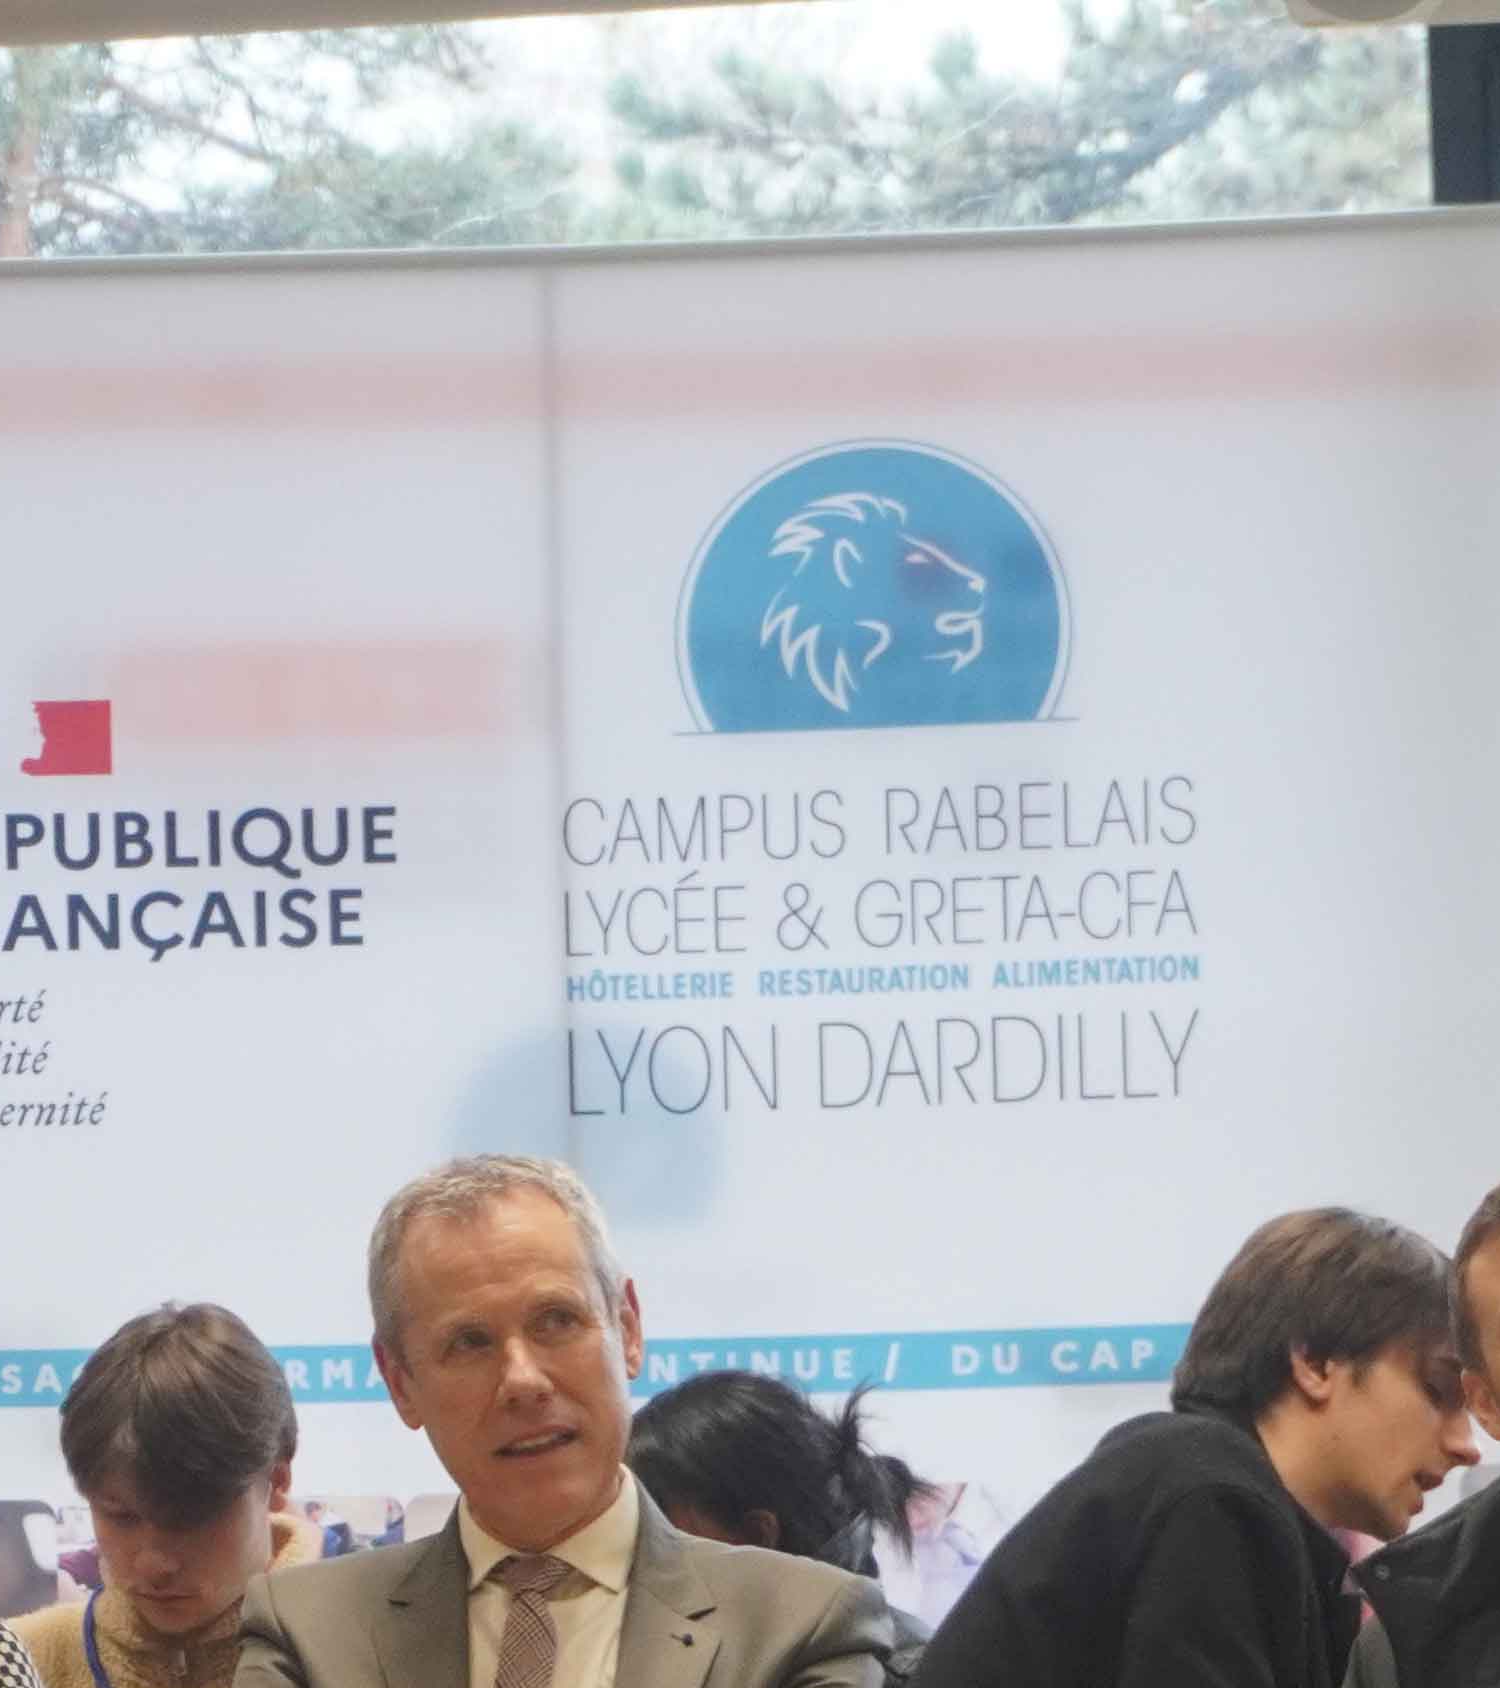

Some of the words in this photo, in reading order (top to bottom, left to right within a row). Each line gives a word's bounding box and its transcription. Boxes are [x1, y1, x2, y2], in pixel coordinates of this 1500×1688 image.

[562, 789, 846, 867] CAMPUS
[884, 775, 1198, 855] RABELAIS
[563, 871, 747, 957] LYCÉE
[775, 882, 831, 952] &
[854, 869, 1199, 948] GRETA-CFA
[566, 968, 735, 1003] HÔTELLERIE
[758, 963, 971, 997] RESTAURATION
[991, 954, 1201, 989] ALIMENTATION
[567, 1023, 779, 1116] LYON
[818, 1008, 1200, 1108] DARDILLY
[648, 1348, 856, 1383] NTINUE
[951, 1343, 1020, 1376] DU
[1051, 1338, 1155, 1374] CAP
